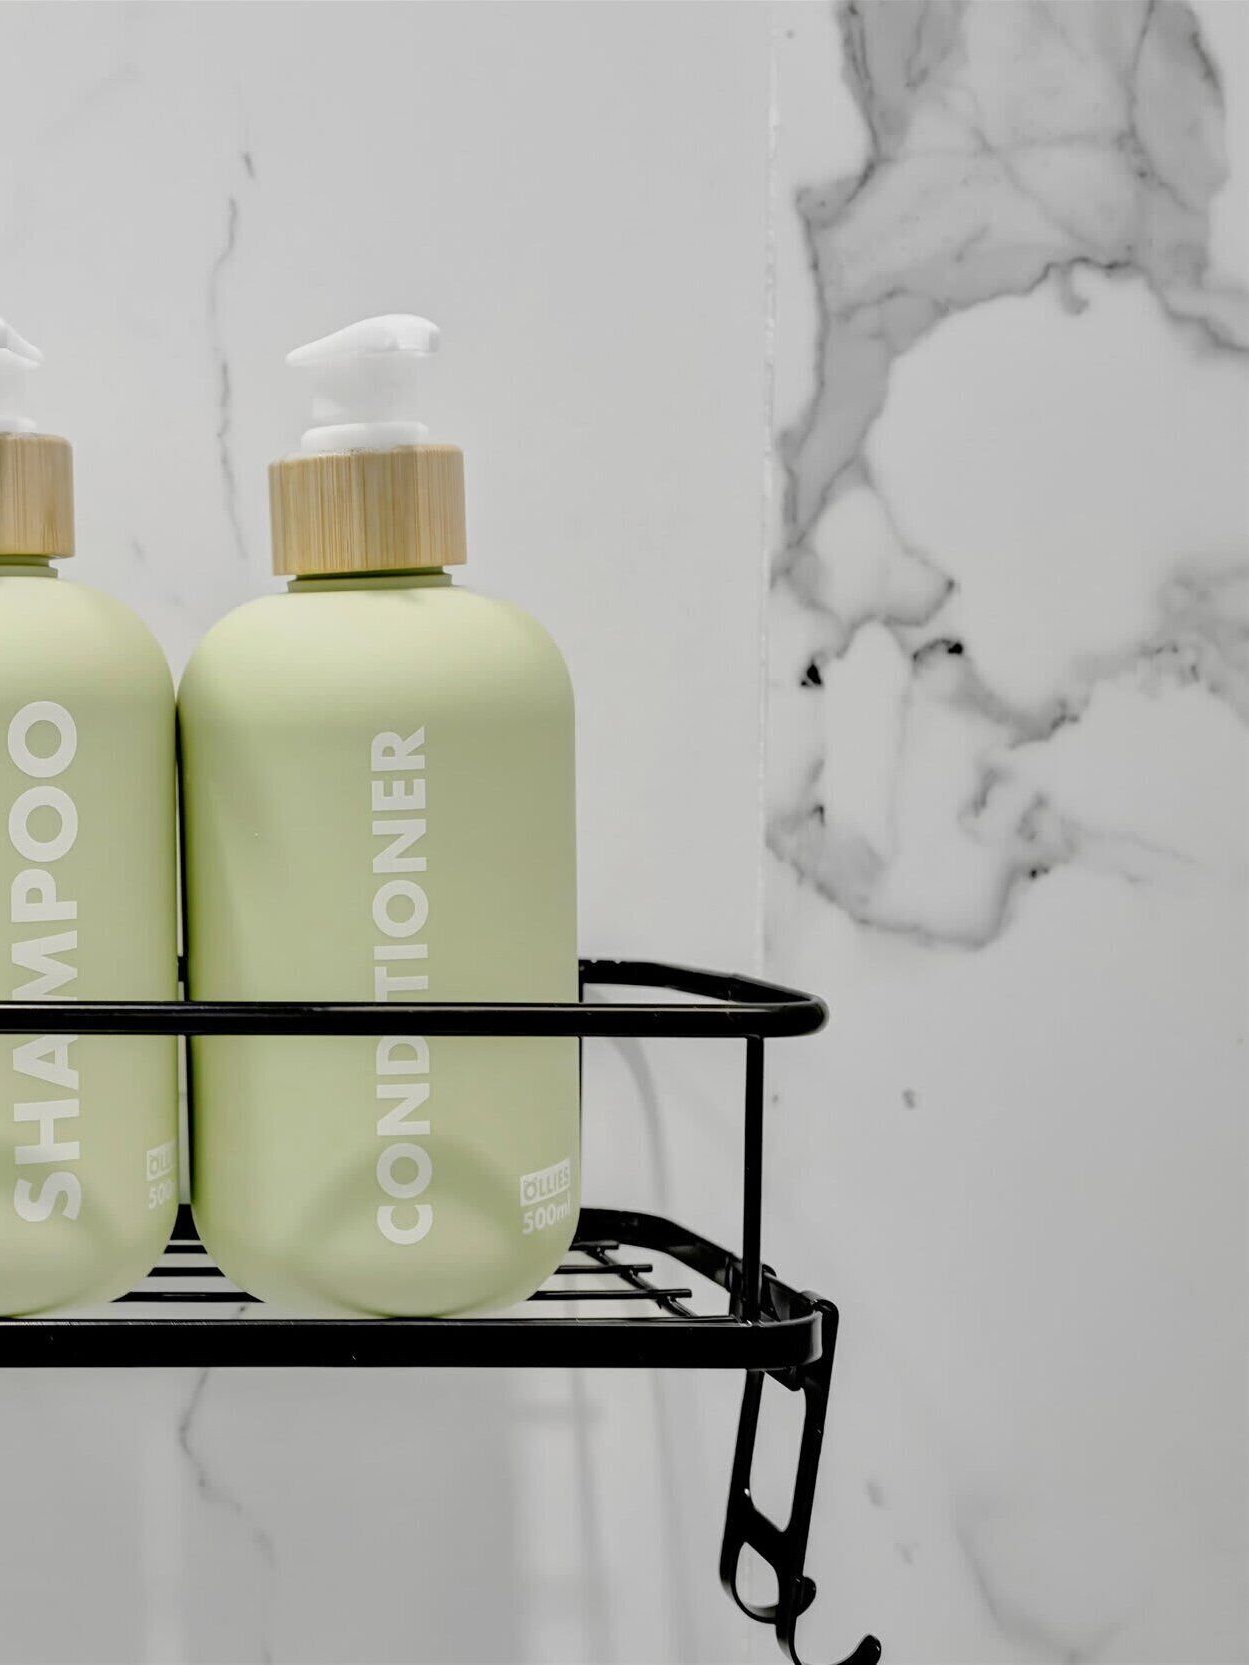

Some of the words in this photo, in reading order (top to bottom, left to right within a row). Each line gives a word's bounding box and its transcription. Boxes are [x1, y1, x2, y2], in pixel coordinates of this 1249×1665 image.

[7, 700, 82, 1222] SHAMPOO
[371, 725, 434, 1245] CONDTIONER
[522, 1187, 571, 1235] 500ml
